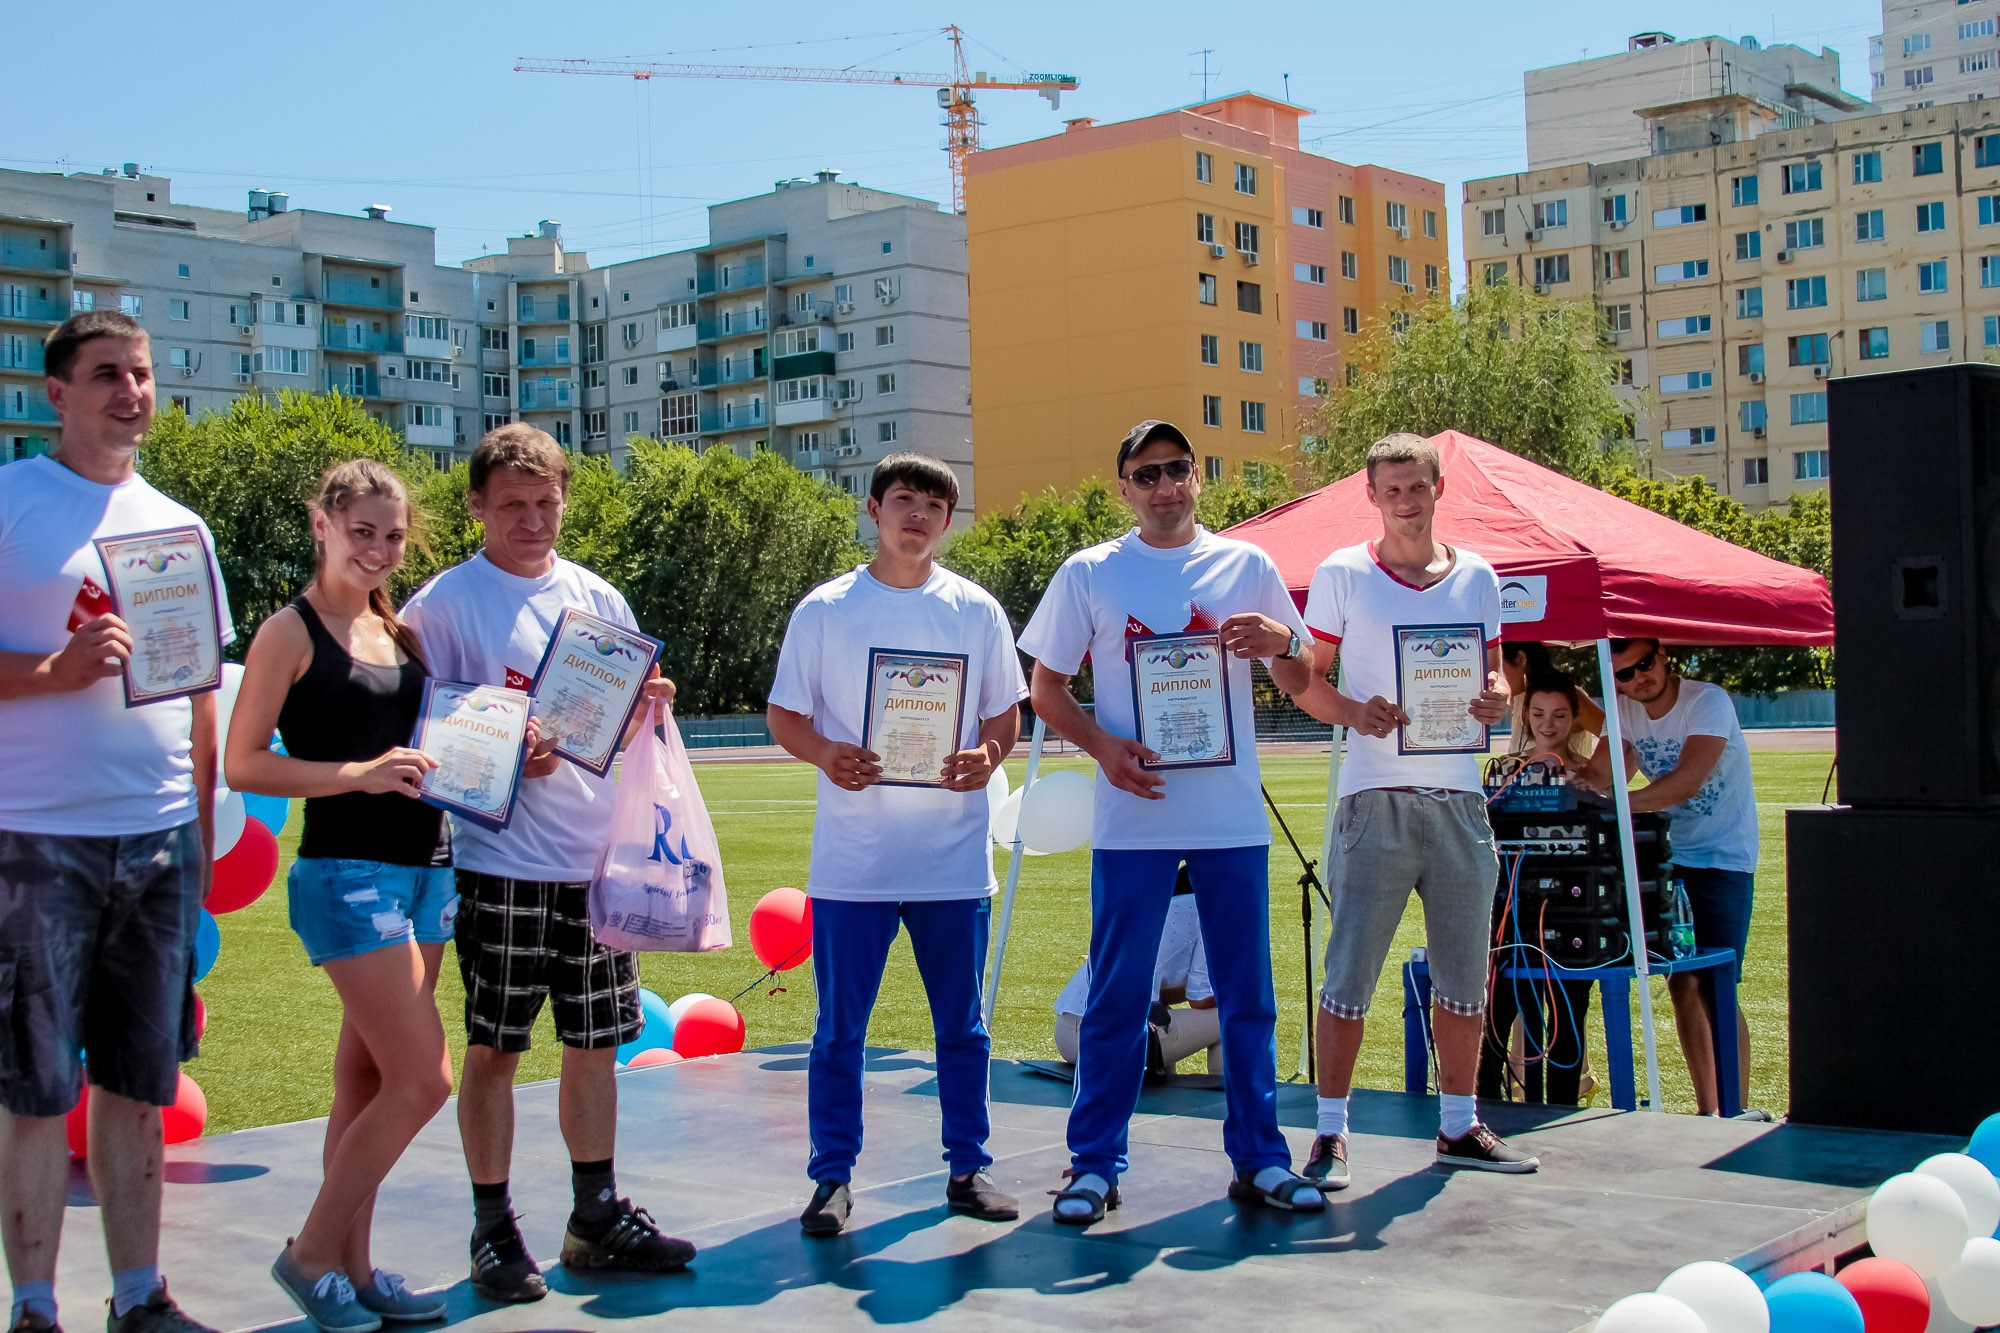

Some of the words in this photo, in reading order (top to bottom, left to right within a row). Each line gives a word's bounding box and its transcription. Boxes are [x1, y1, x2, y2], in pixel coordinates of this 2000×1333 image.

[133, 583, 200, 608] ДИПЛОМ
[563, 653, 627, 691] ДИПЛОМ
[1414, 667, 1472, 681] ДИПЛОМ
[1150, 678, 1212, 695] ДИПЛОМ
[884, 697, 947, 713] ДИПЛОМ
[441, 714, 510, 741] ДИПЛОМ
[1515, 788, 1559, 796] Soundcraft
